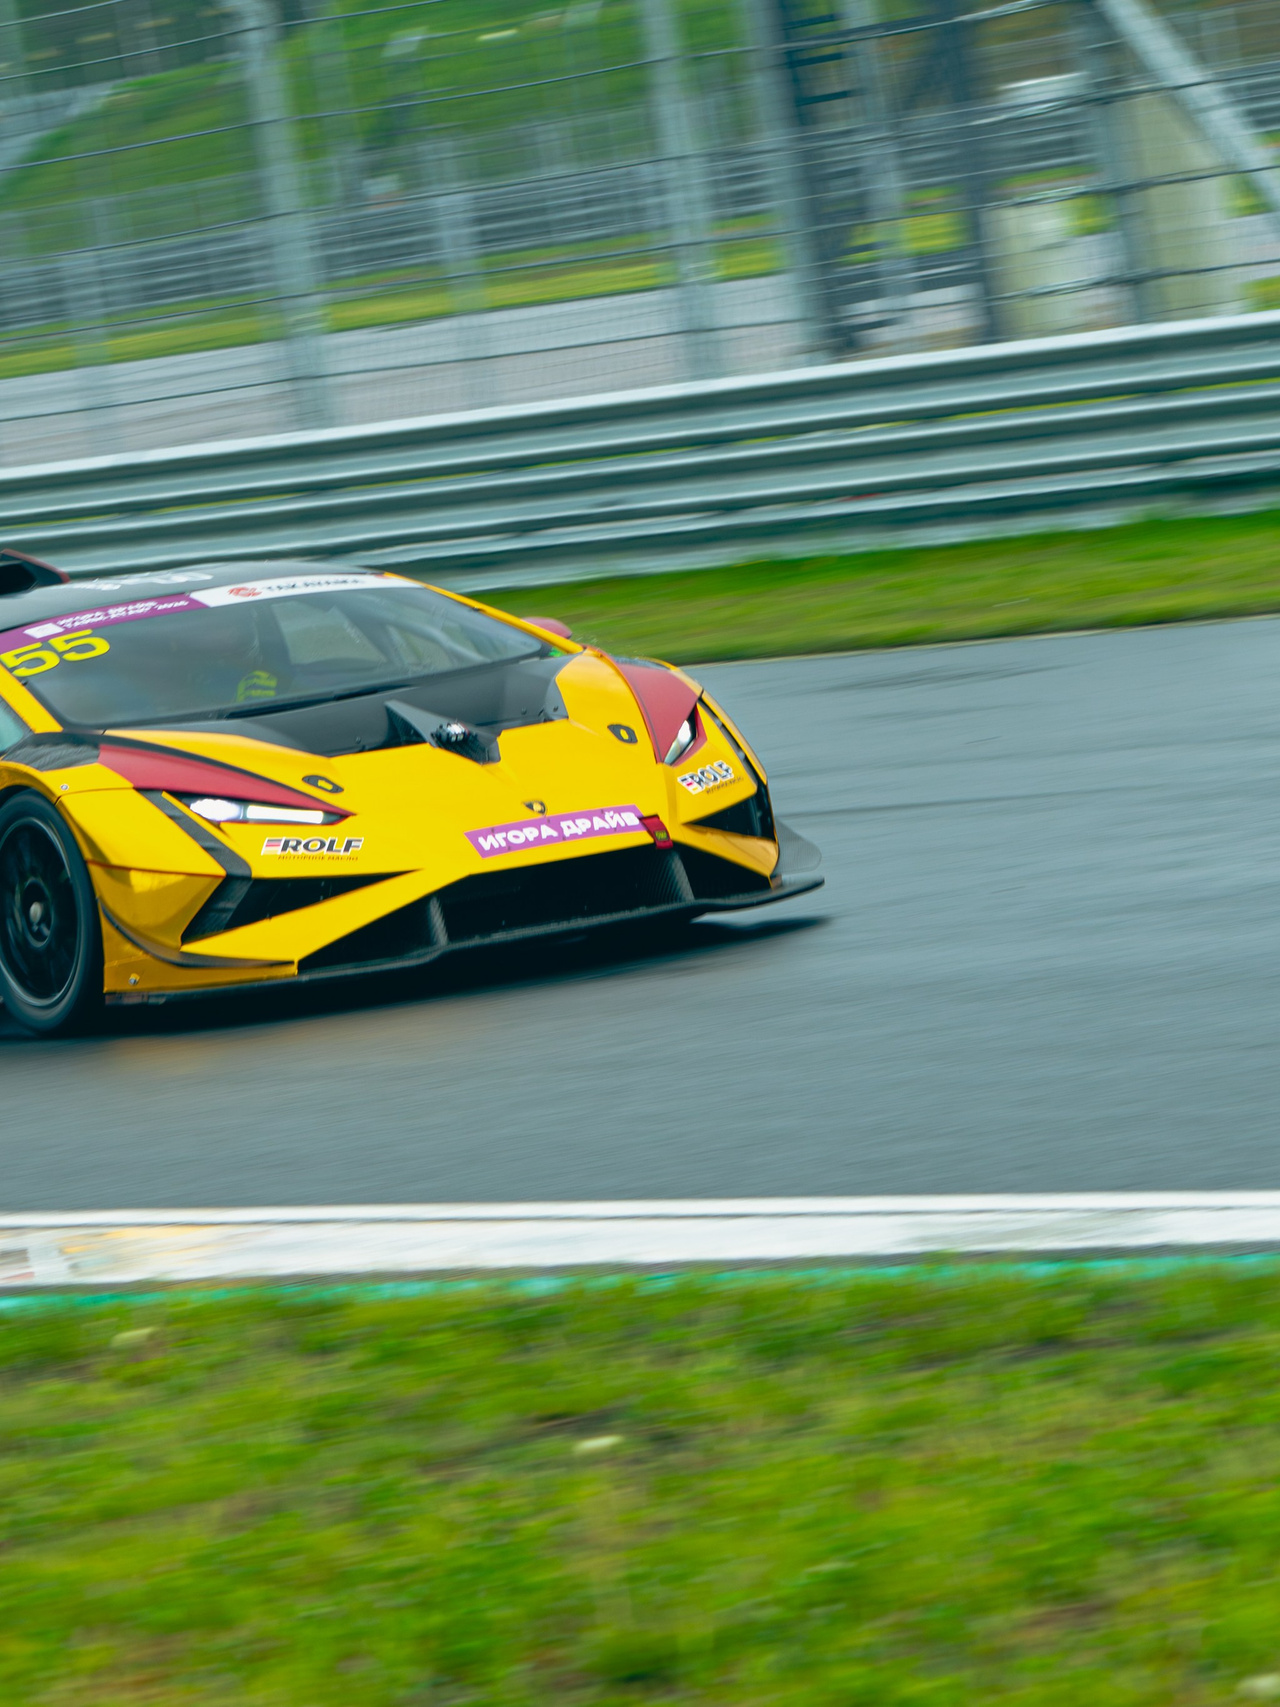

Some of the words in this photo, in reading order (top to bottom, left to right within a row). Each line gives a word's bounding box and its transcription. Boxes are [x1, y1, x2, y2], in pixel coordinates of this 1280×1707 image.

[686, 760, 735, 791] ROLF
[279, 837, 365, 856] ROLF
[477, 824, 558, 851] ИГОРА
[559, 811, 641, 838] ДРАЙВ
